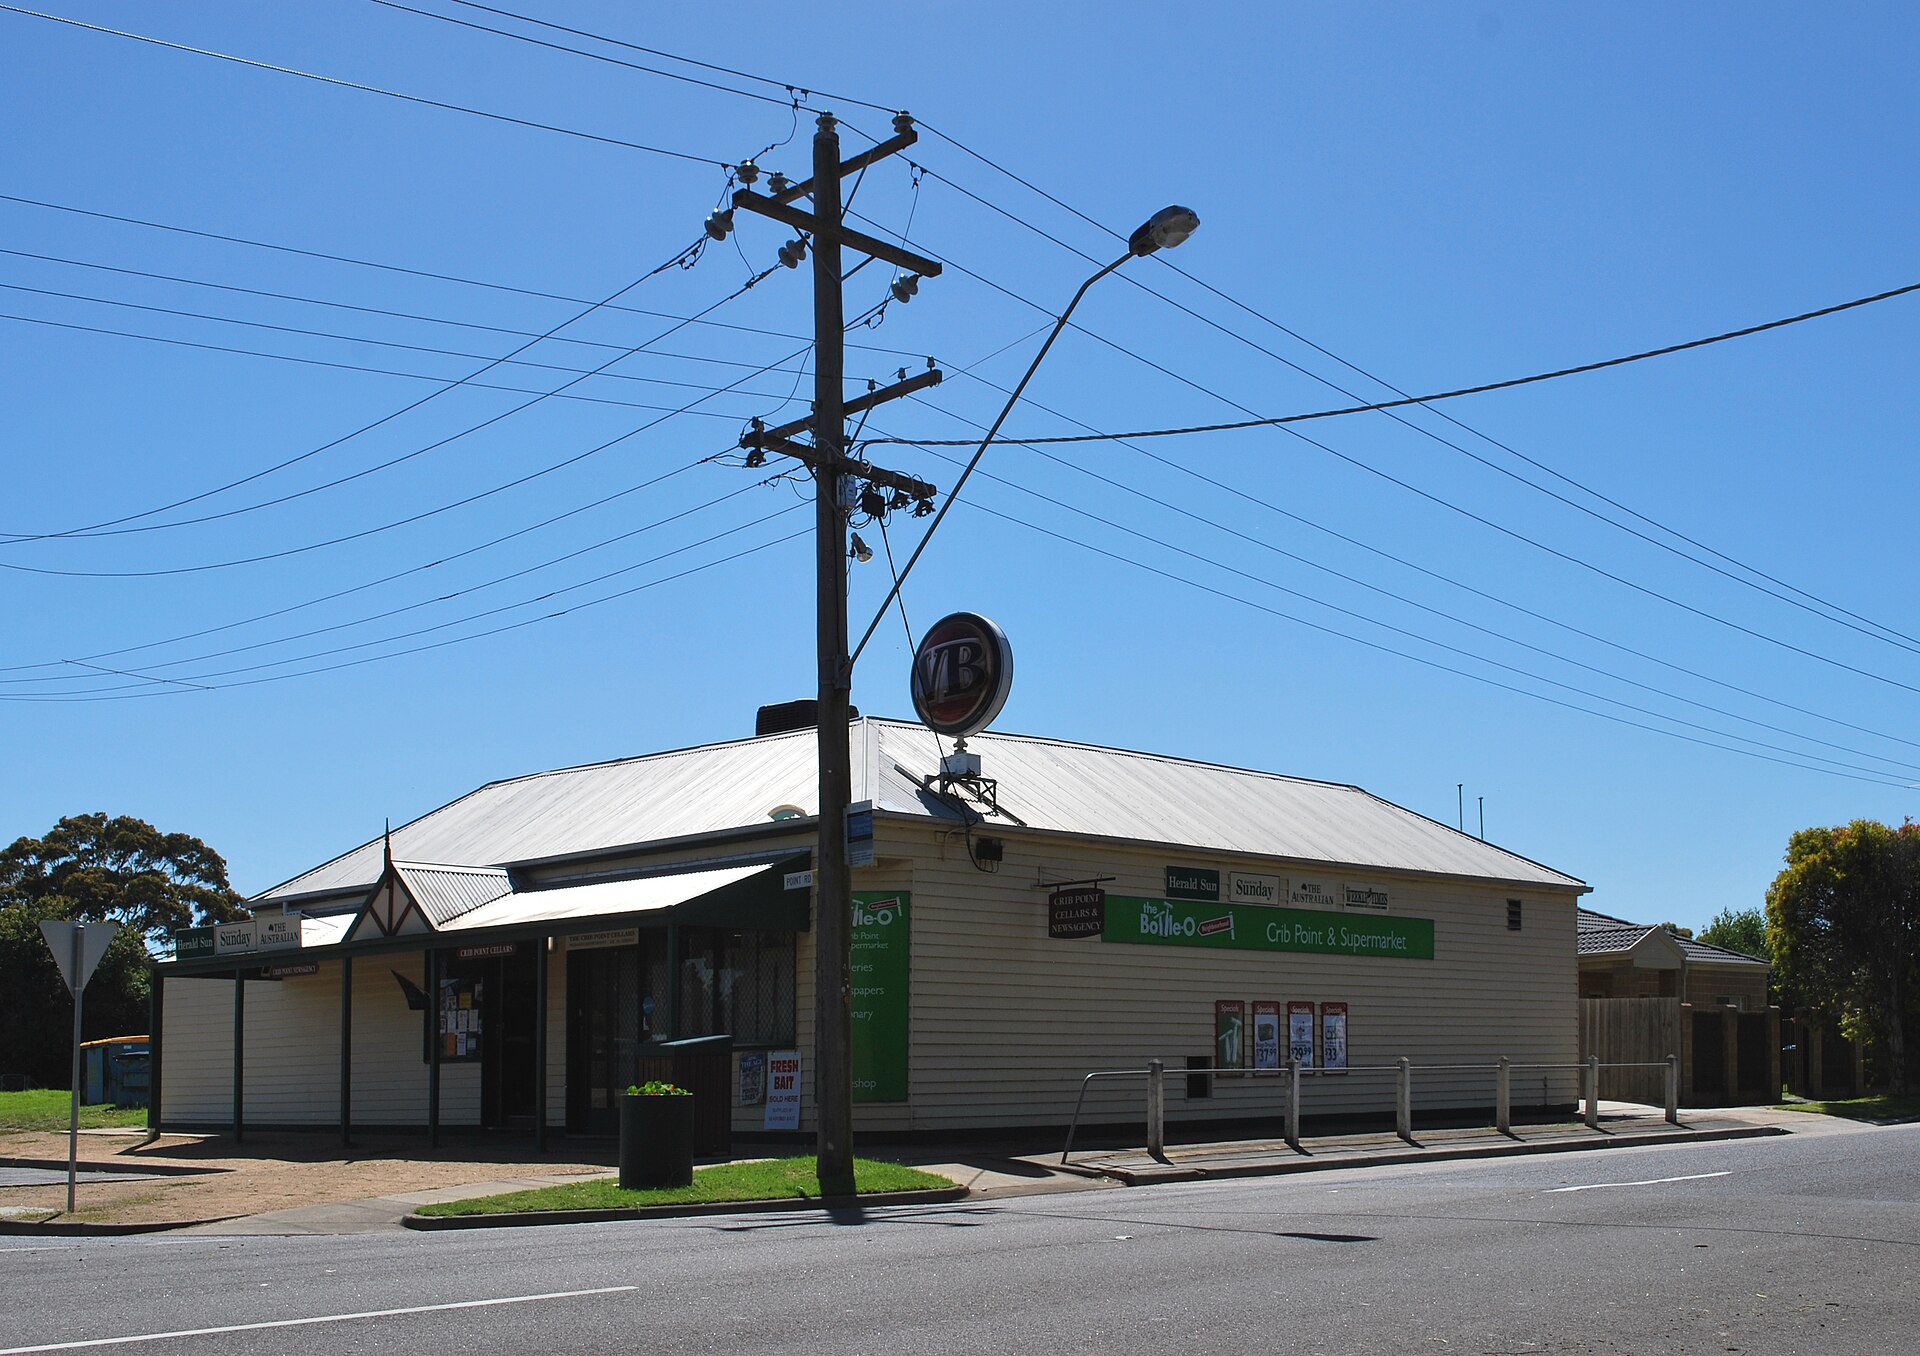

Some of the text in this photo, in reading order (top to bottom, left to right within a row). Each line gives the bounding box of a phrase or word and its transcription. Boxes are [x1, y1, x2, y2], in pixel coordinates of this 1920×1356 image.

[917, 640, 988, 703] VB
[1169, 876, 1217, 891] Herald Sun
[1236, 878, 1274, 900] Sunday
[1307, 883, 1321, 893] THE
[1053, 893, 1100, 906] CRIB POINT
[1292, 891, 1334, 905] AUSTRALIAN
[1055, 907, 1098, 920] CELLARS &
[1143, 901, 1158, 914] the
[274, 923, 286, 932] THE
[1051, 921, 1101, 933] NEWSAGENCY
[220, 929, 252, 947] Sunday
[260, 931, 299, 945] AUSTRALIAN
[860, 931, 879, 940] Point
[1266, 921, 1407, 952] Crib Point & Supermarket
[177, 936, 213, 951] Herald Sun
[850, 940, 889, 951] permarket
[460, 945, 513, 957] CRIB POINT CELLARS
[851, 963, 873, 972] eries
[850, 988, 885, 998] spapers
[1221, 1003, 1239, 1013] Specials
[1256, 1005, 1275, 1014] Specials
[1291, 1005, 1310, 1014] Specials
[770, 1059, 799, 1073] FRESH
[774, 1075, 794, 1090] BAIT
[769, 1095, 784, 1103] SOLD
[784, 1095, 799, 1103] HERE
